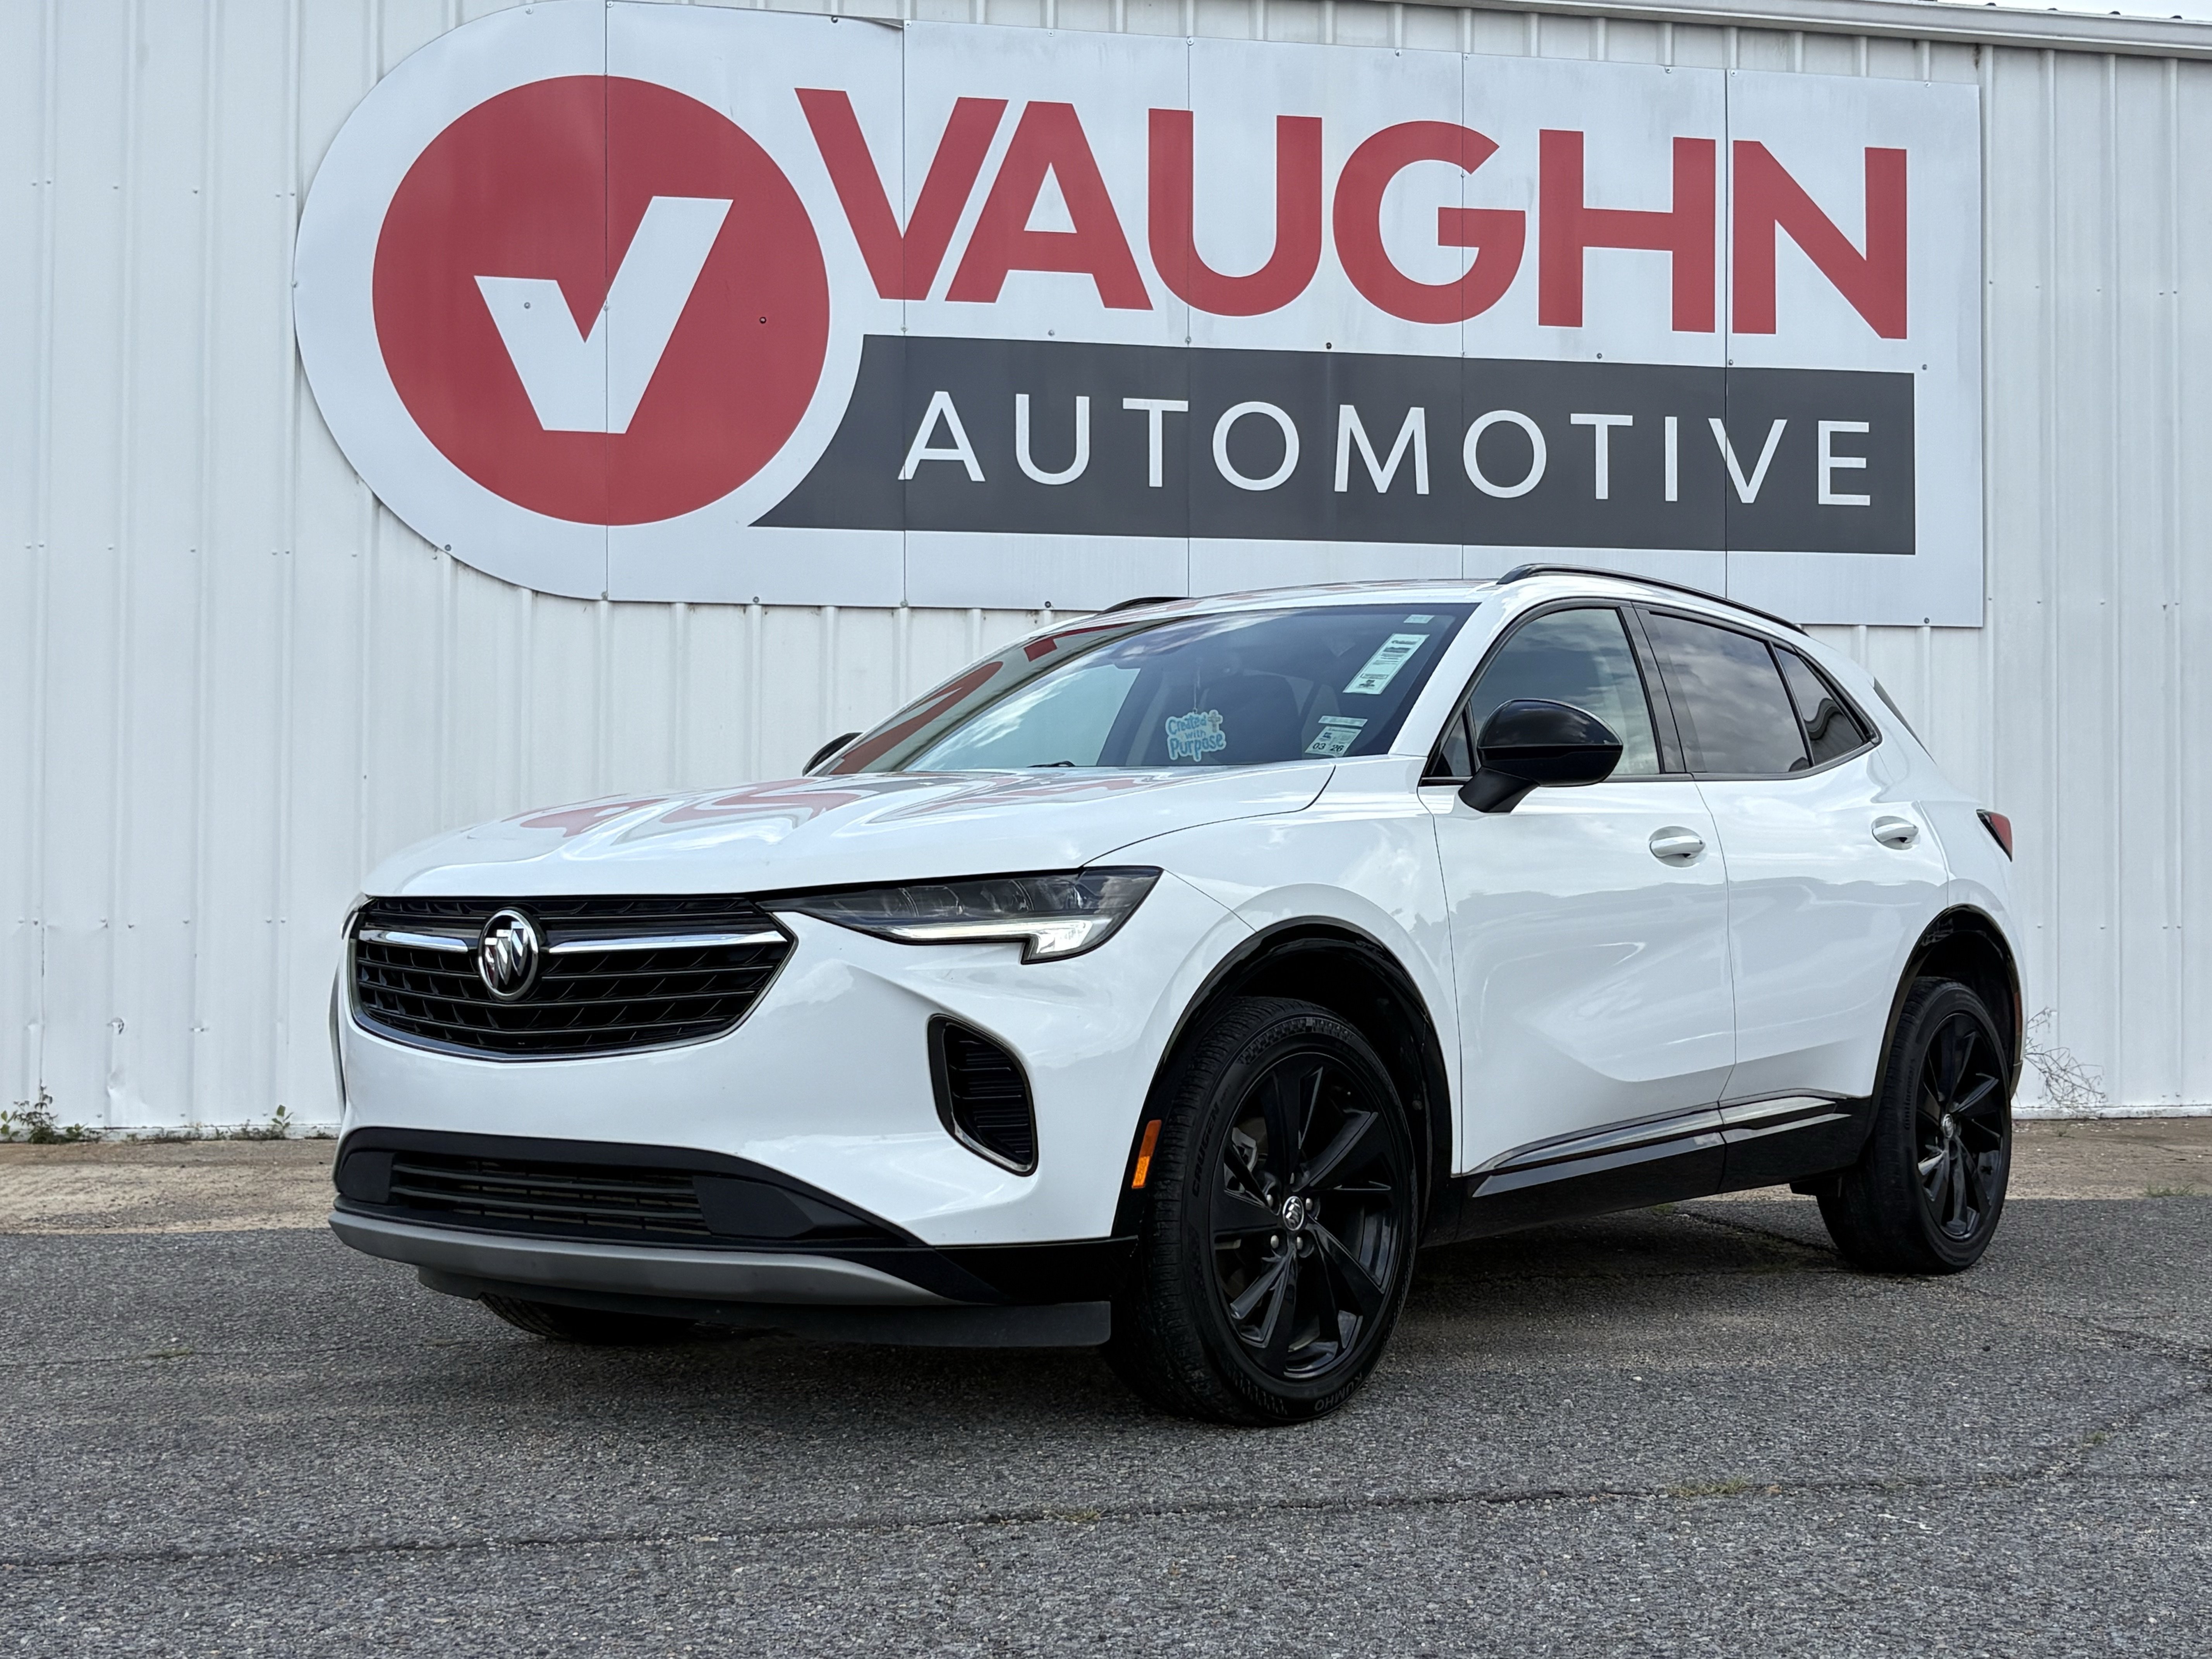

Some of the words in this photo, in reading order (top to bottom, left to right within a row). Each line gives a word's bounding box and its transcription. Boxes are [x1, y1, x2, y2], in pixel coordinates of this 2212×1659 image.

[796, 89, 1906, 339] VAUGHN
[898, 391, 1870, 507] AUTOMOTIVE
[1168, 714, 1207, 735] Created
[1185, 730, 1206, 739] with
[1170, 733, 1223, 759] Purpose
[1192, 1101, 1220, 1198] CRUGEN
[1314, 1371, 1362, 1412] KUMHO
